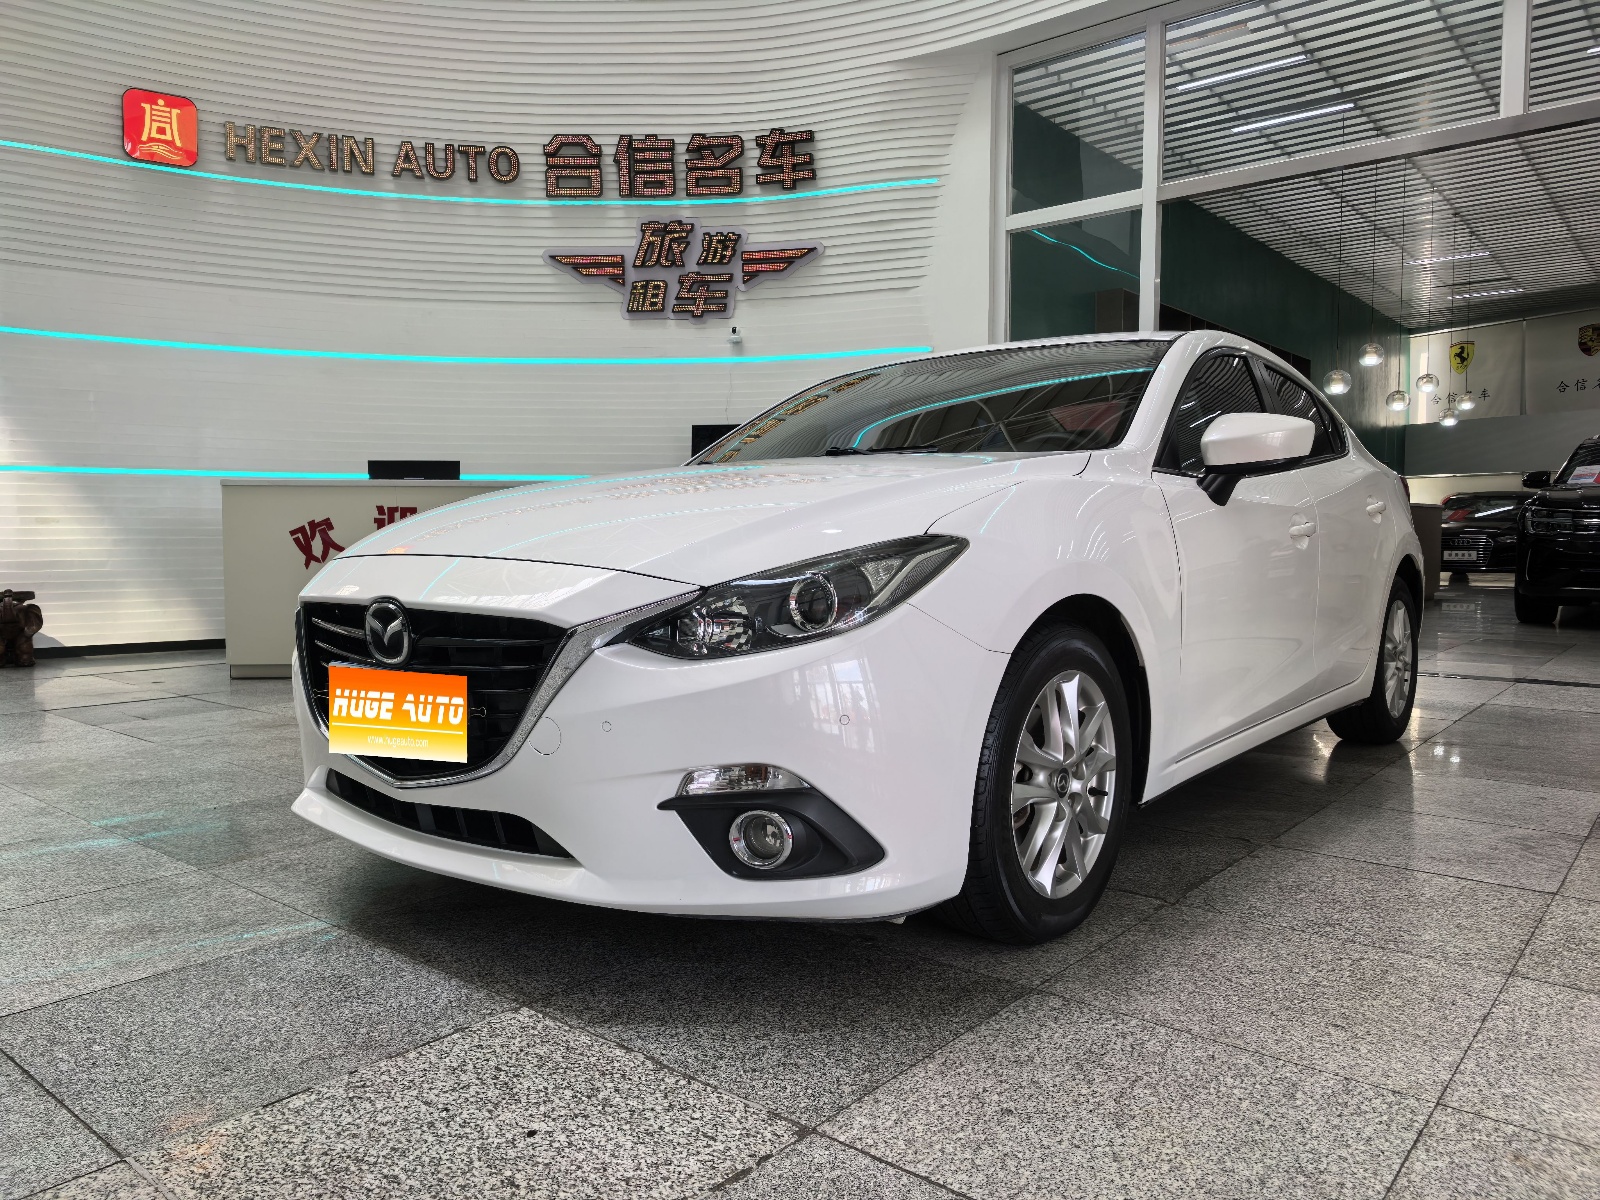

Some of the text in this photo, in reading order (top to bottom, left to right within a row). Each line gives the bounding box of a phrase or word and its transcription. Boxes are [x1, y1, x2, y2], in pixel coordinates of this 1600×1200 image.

[224, 121, 375, 176] HEXIN
[392, 140, 520, 184] AUTO
[543, 128, 816, 198] 合信名车
[632, 220, 742, 268] 旅游
[626, 271, 733, 317] 租车
[1431, 388, 1491, 405] 合信车
